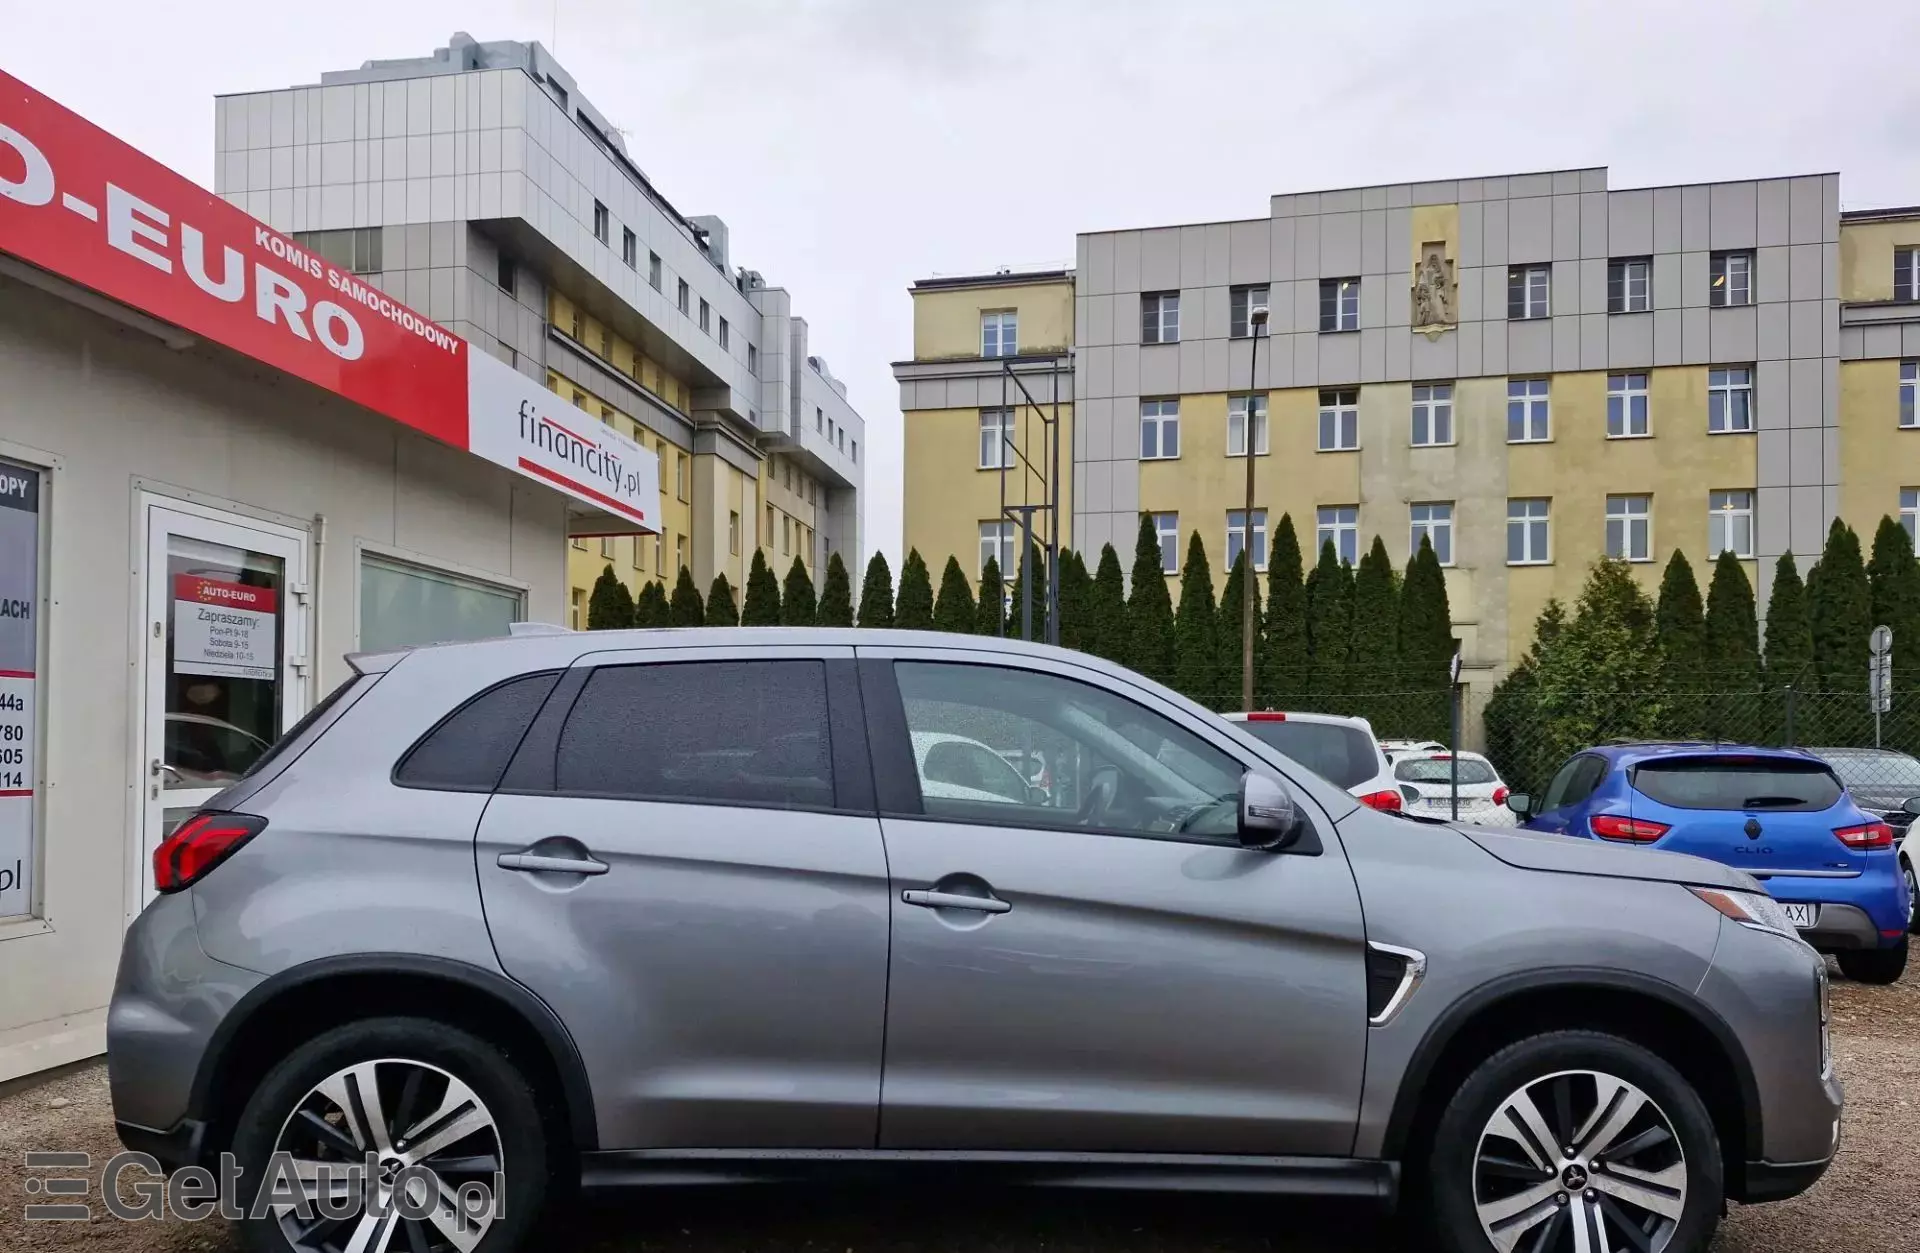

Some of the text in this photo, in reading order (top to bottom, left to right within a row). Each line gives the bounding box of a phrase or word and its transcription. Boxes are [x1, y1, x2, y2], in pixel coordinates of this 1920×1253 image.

[255, 226, 459, 355] KOMIS SAMOCHODOWY
[518, 399, 641, 498] financity.pl
[203, 586, 256, 602] AUTO-EURO
[0, 599, 31, 620] ACH
[197, 607, 260, 629] Zapraszamy:
[209, 625, 233, 637] Pon-Pt
[209, 637, 233, 648] Sobota
[0, 692, 24, 712] 44a
[0, 748, 23, 765] 05
[0, 771, 23, 788] 14
[1733, 846, 1775, 855] CLIO
[1785, 905, 1806, 922] AX
